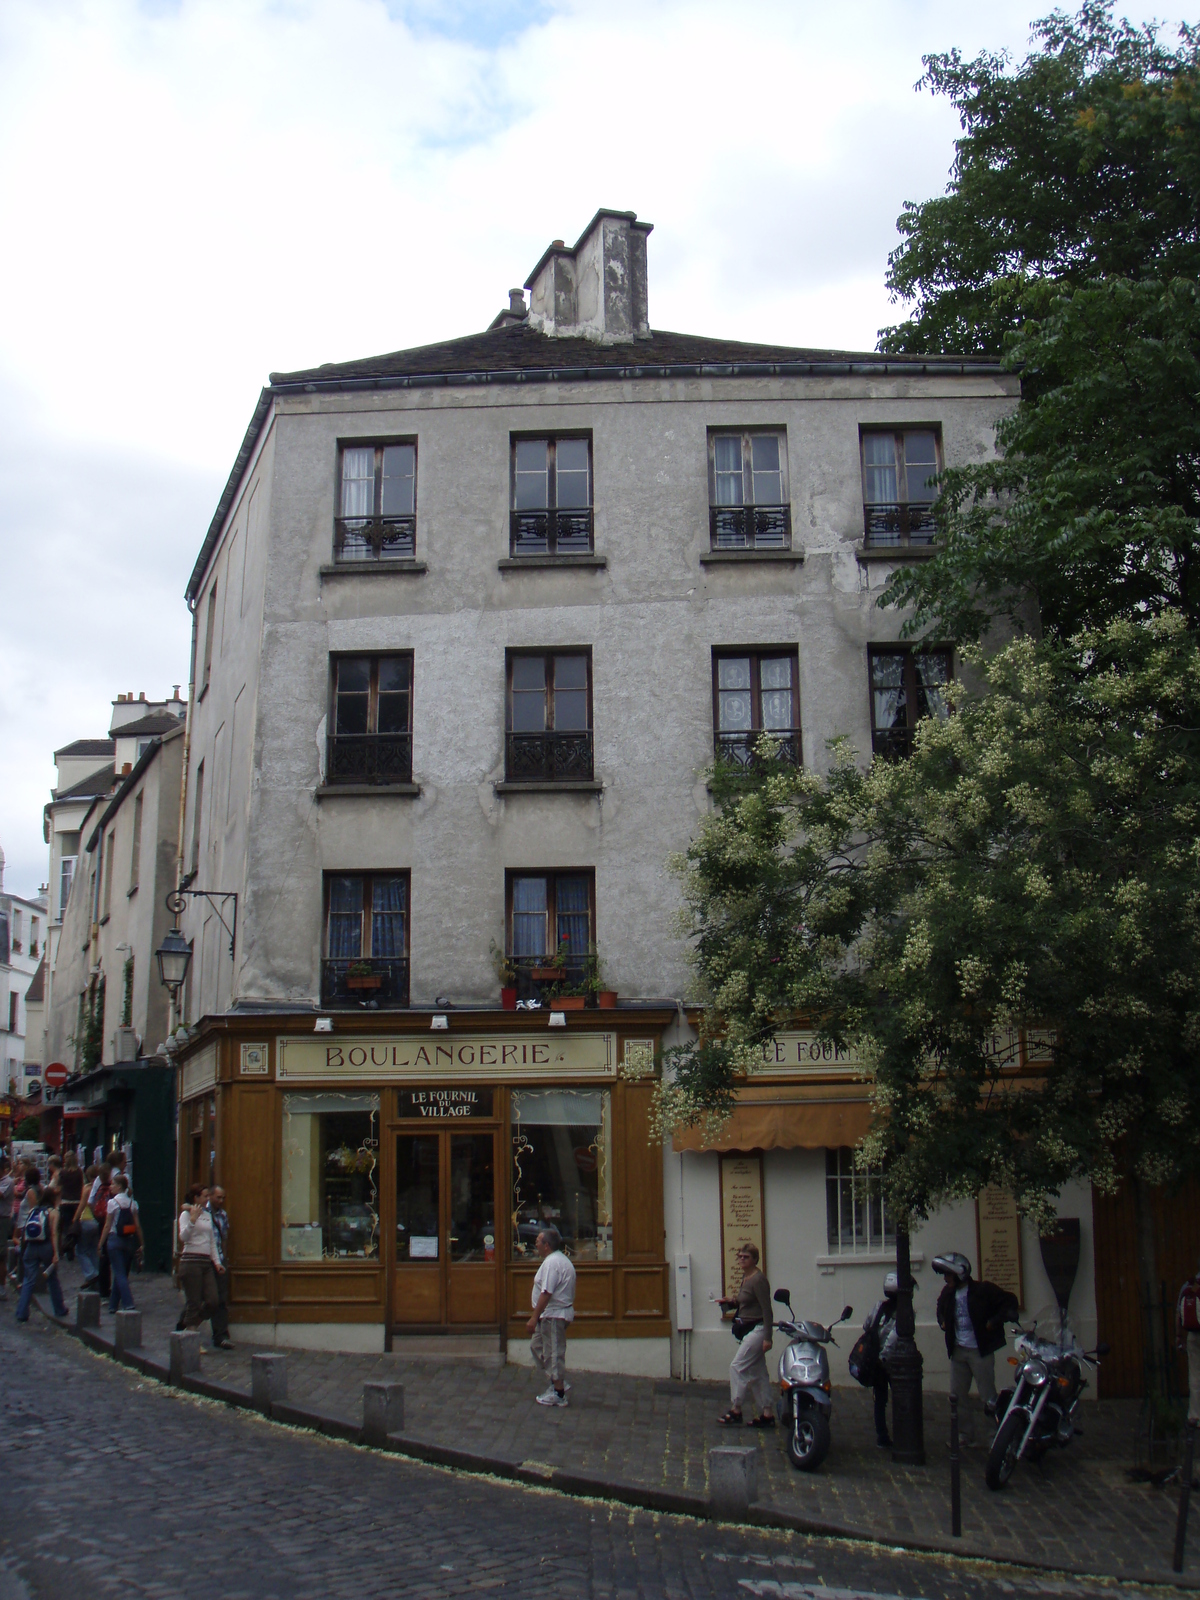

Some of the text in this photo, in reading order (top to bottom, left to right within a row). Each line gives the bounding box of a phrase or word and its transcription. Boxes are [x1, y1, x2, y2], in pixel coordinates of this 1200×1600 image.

[325, 1044, 550, 1067] BOULANGERIE
[763, 1039, 786, 1063] LE
[411, 1090, 480, 1105] LE FOURNIL
[420, 1105, 471, 1117] VILLAGE
